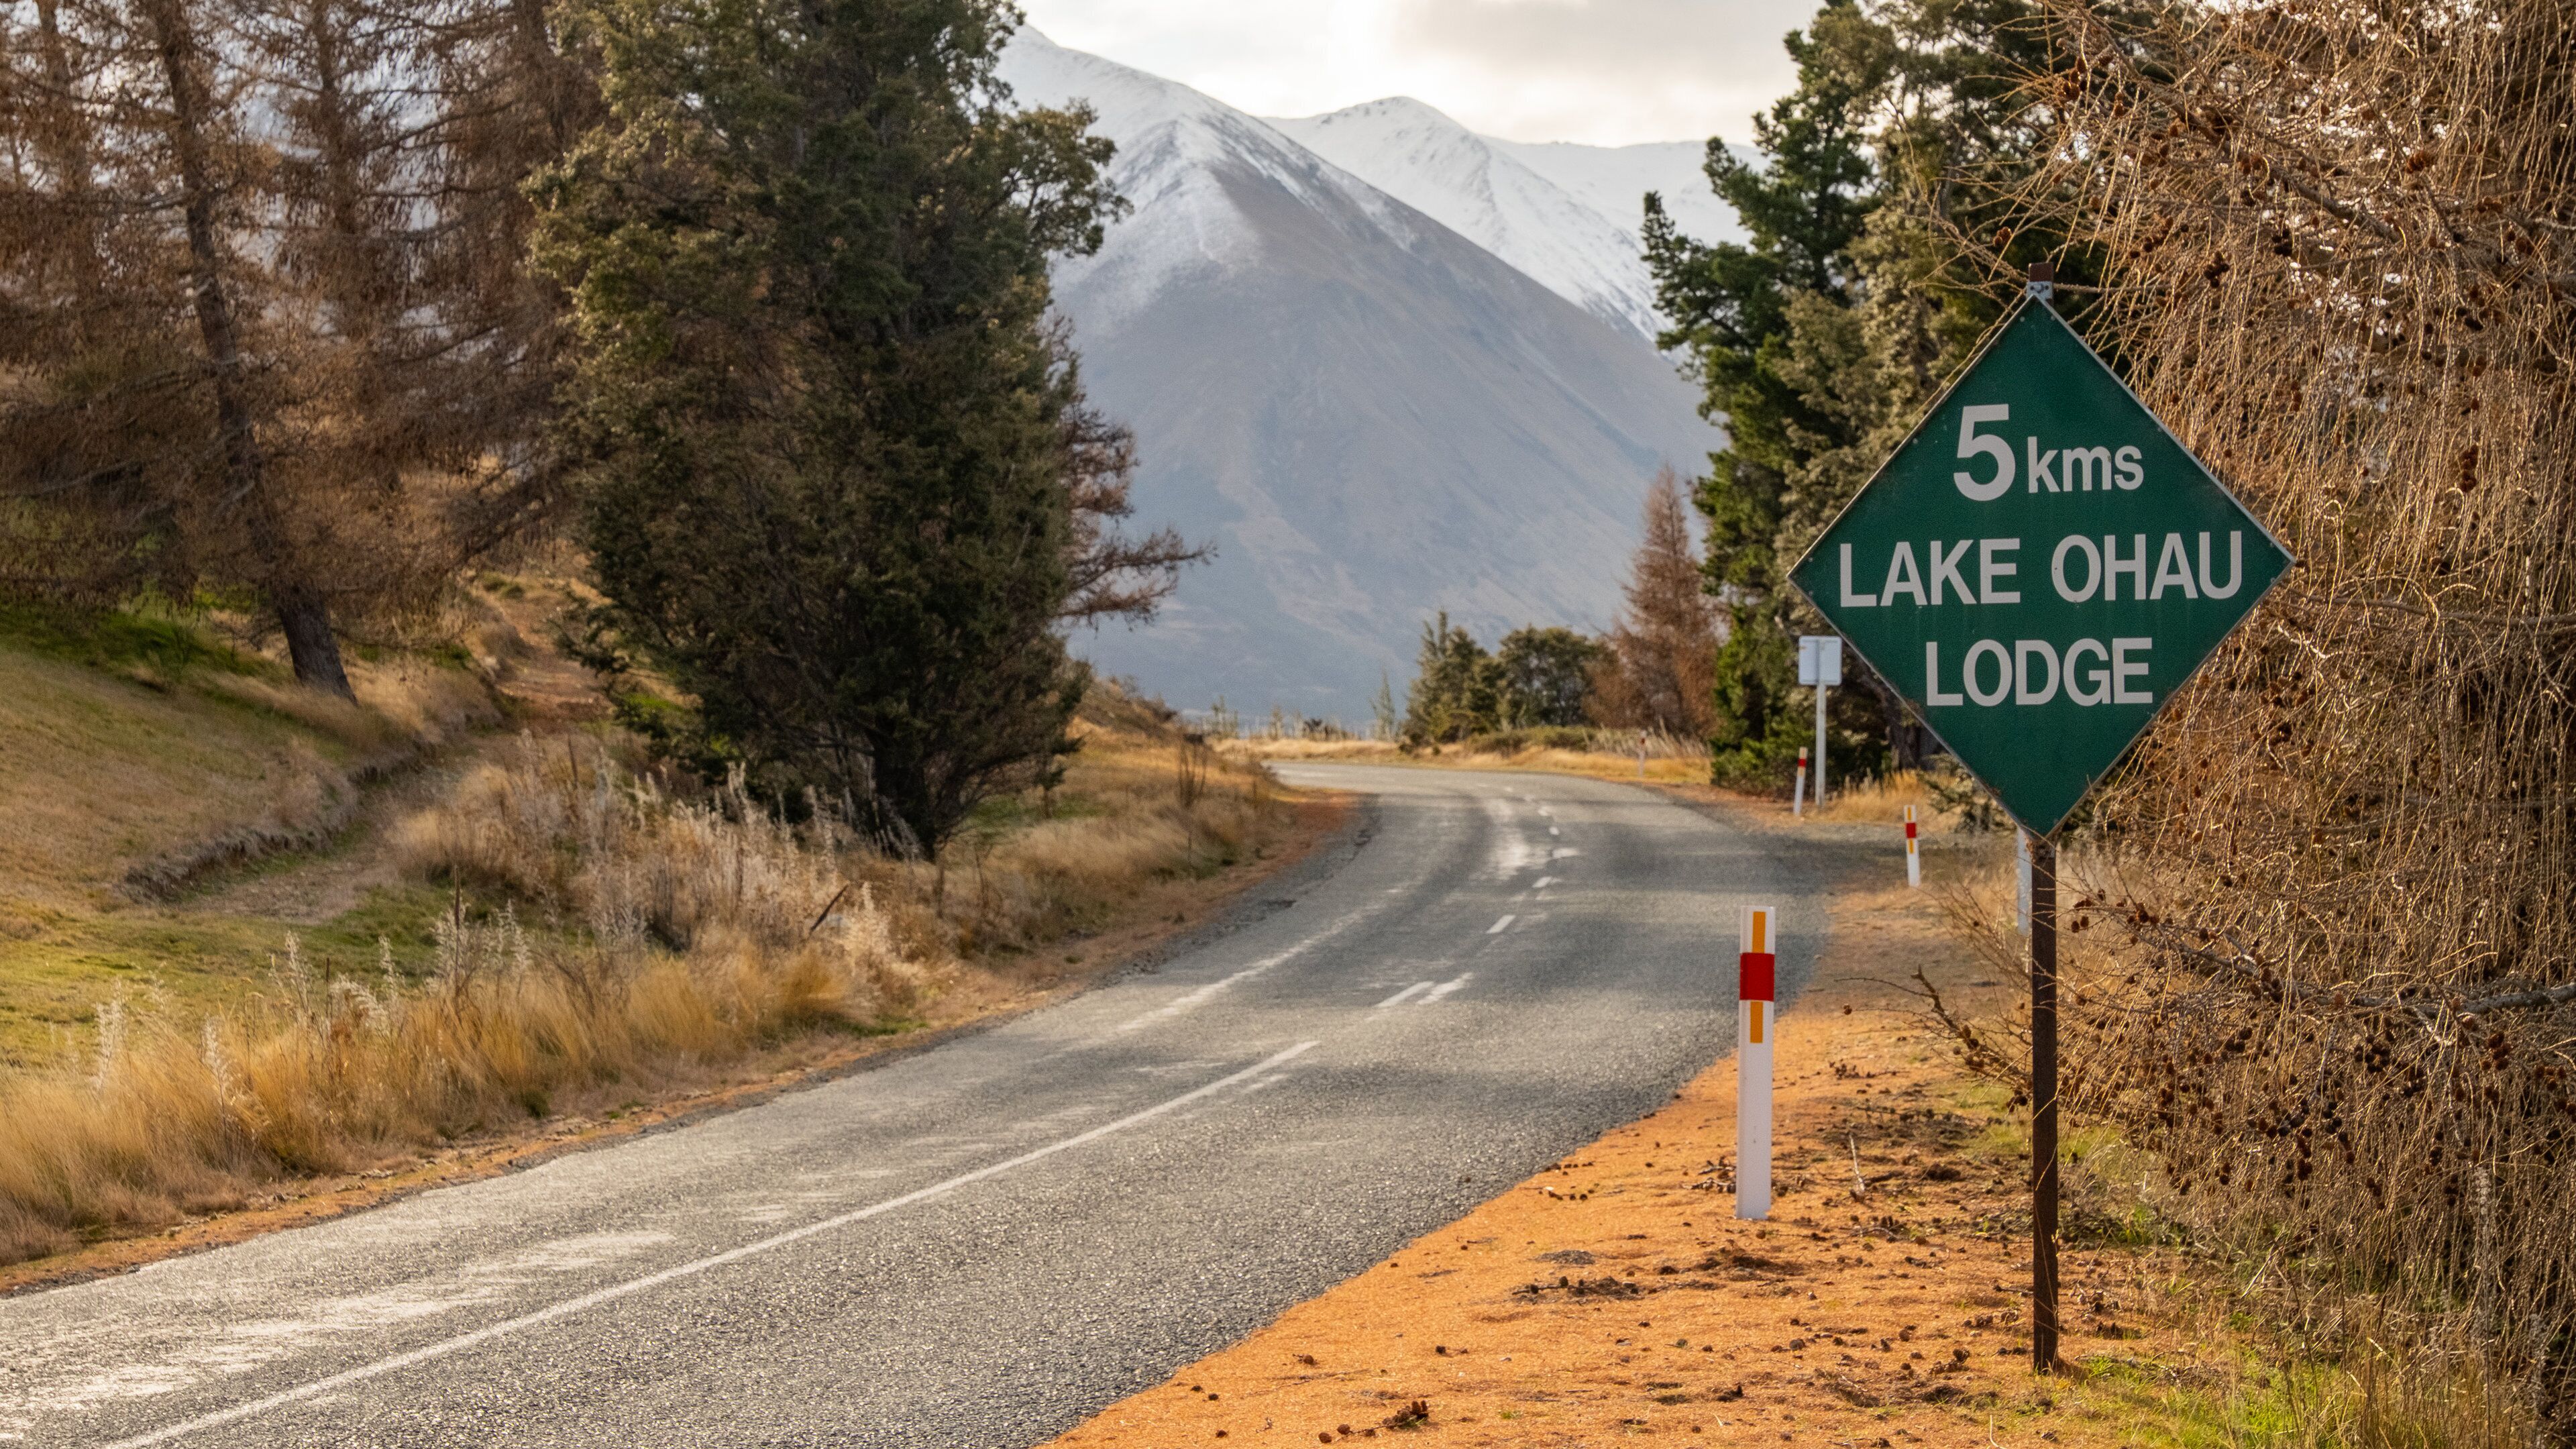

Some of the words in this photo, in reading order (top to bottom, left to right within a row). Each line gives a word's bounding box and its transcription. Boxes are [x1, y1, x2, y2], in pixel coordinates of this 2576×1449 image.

[1954, 404, 2016, 501] 5
[2028, 437, 2144, 493] kms
[1841, 539, 2021, 607] LAKE
[2051, 531, 2242, 602] OHAU
[1926, 637, 2153, 706] LODGE
